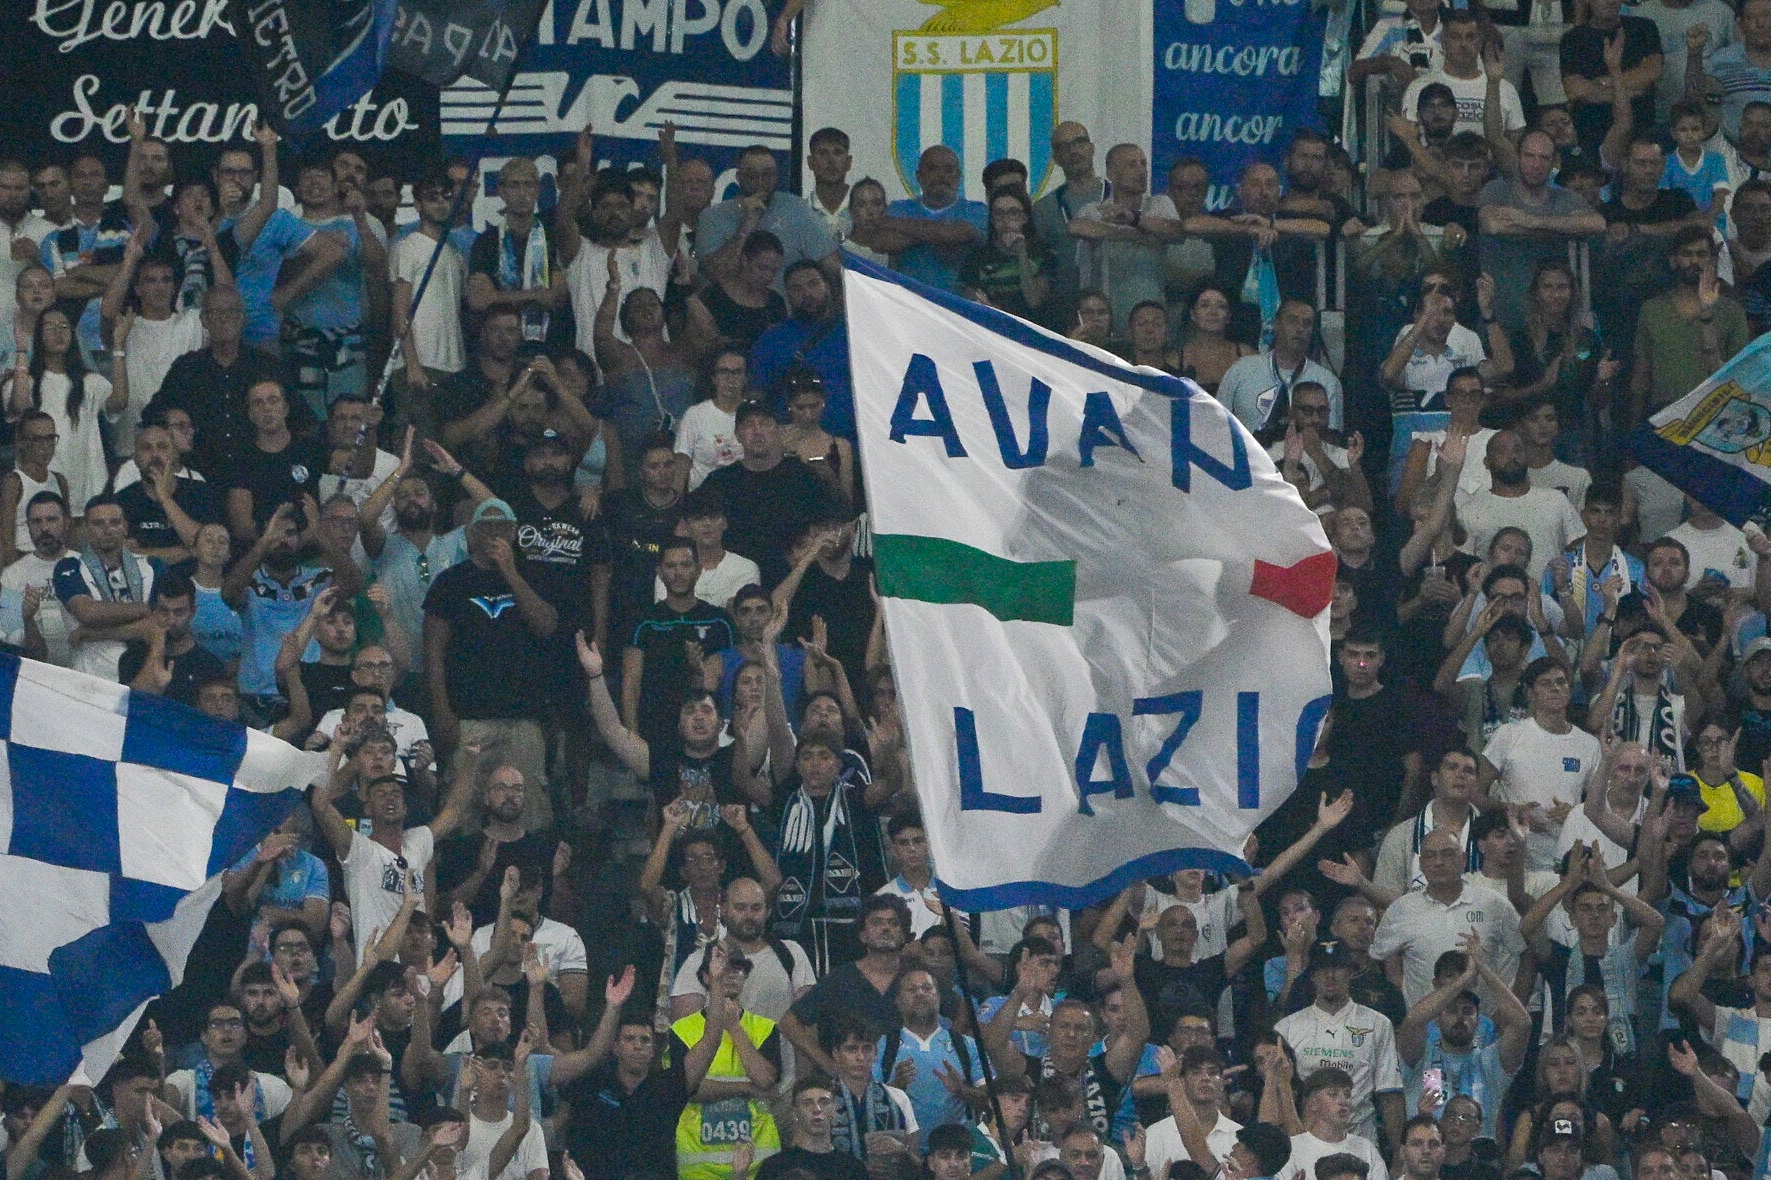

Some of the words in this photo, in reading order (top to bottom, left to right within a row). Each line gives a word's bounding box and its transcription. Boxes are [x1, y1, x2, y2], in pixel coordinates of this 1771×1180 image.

[959, 34, 1049, 66] LAZIO
[1165, 41, 1303, 77] ancora
[1175, 111, 1284, 145] ancor
[888, 352, 1253, 494] AVAN
[517, 524, 584, 557] Original
[1302, 1046, 1356, 1059] SIEMENS
[700, 1122, 752, 1144] 0439
